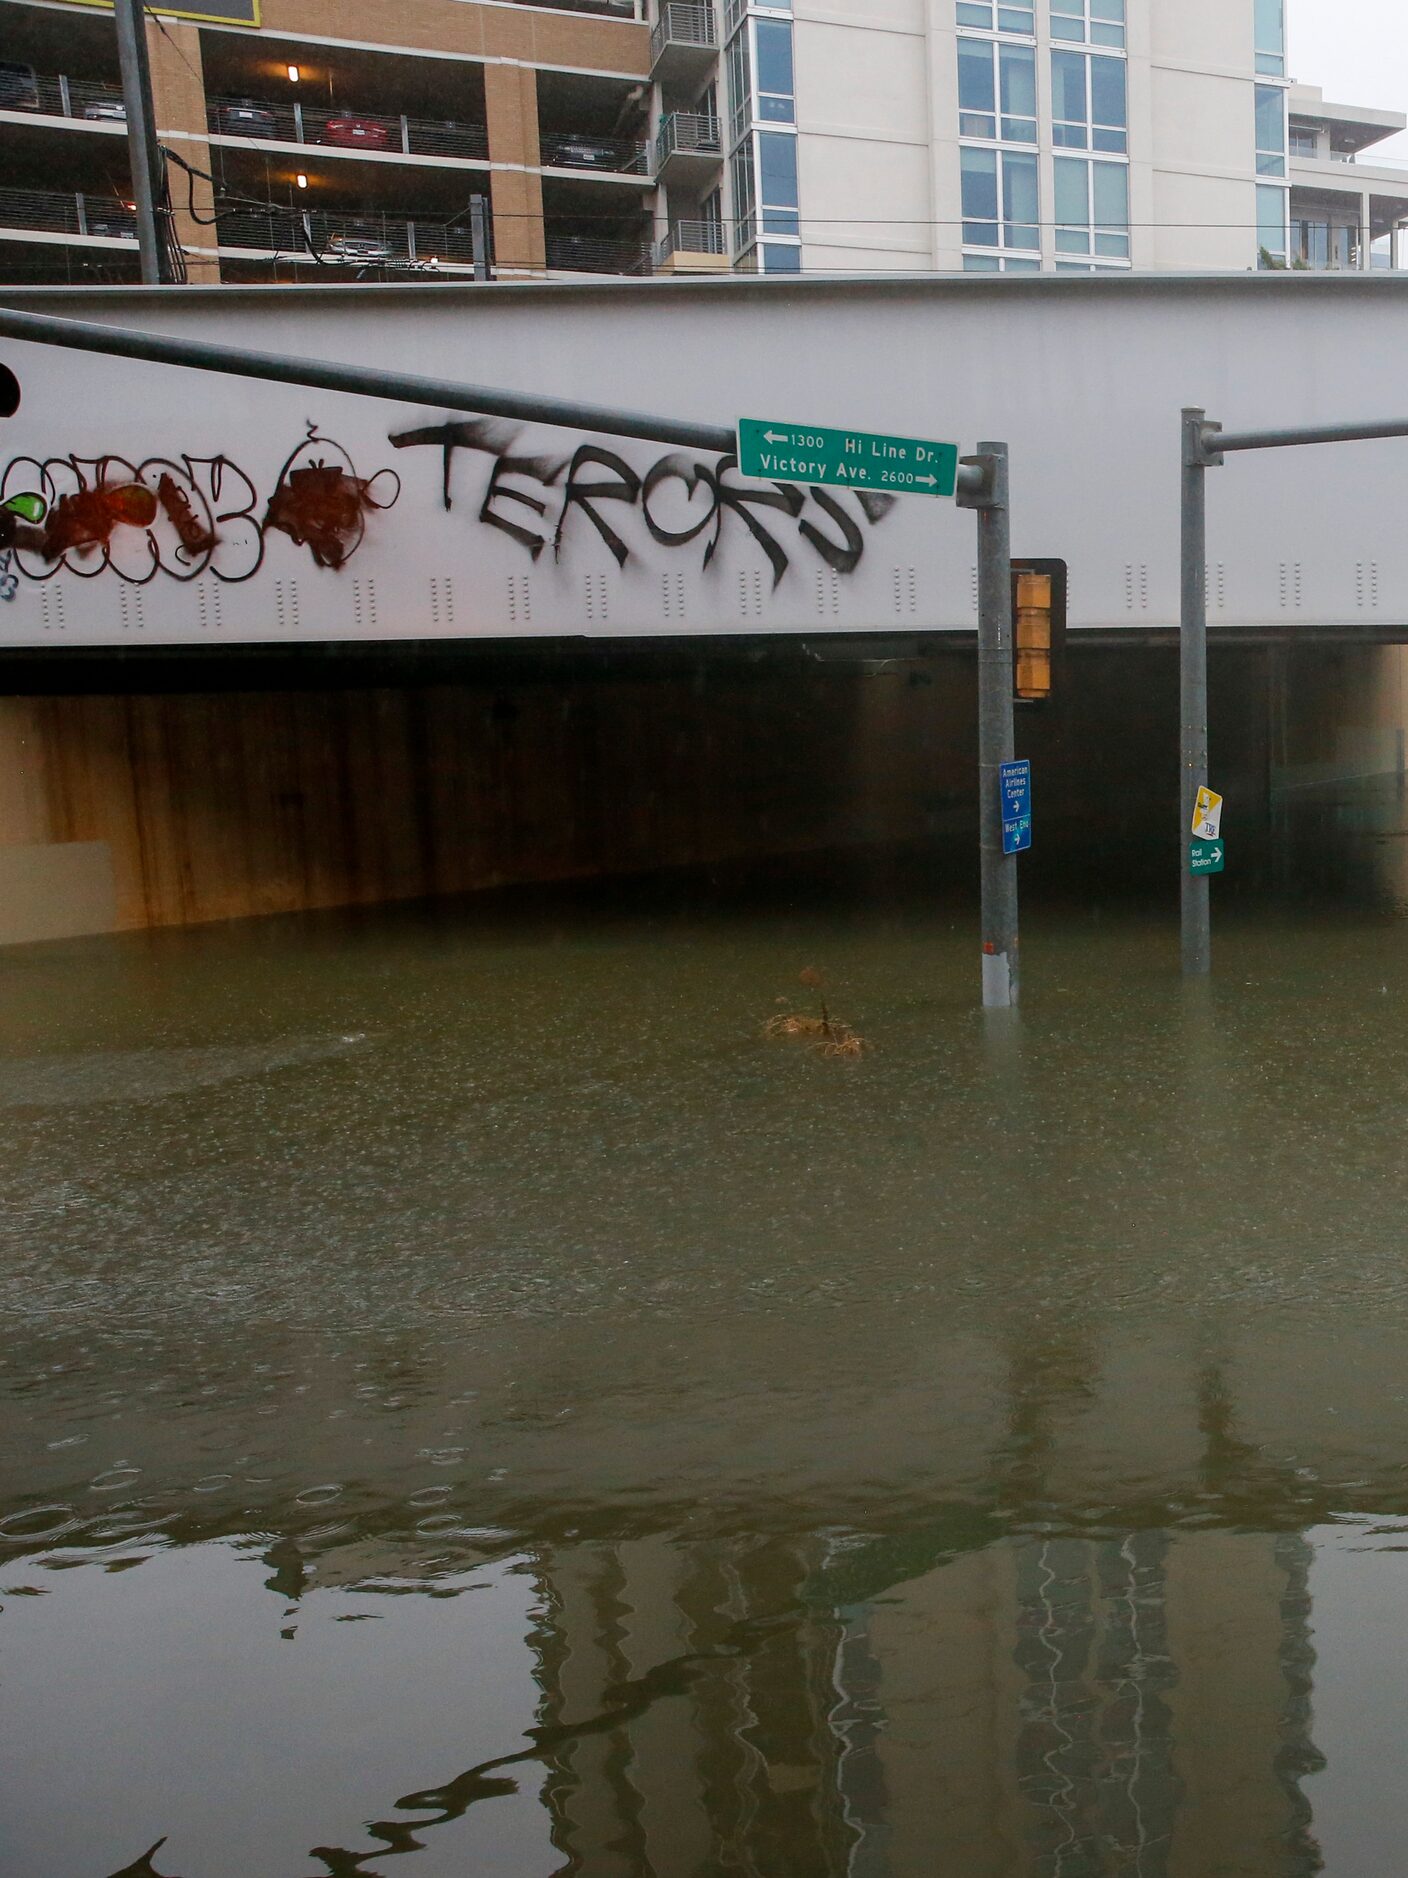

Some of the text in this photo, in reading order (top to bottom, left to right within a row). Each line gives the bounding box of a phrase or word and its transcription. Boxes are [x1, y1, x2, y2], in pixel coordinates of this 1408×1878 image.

[791, 434, 940, 463] 1300 Hi Line Dr.
[760, 454, 914, 484] Victory Ave. 2600
[1003, 766, 1028, 778] American
[1005, 777, 1026, 788] Airlines
[1007, 787, 1025, 799] Center
[1005, 821, 1018, 833] West
[1191, 848, 1203, 857] Rail
[1191, 858, 1212, 868] Station
